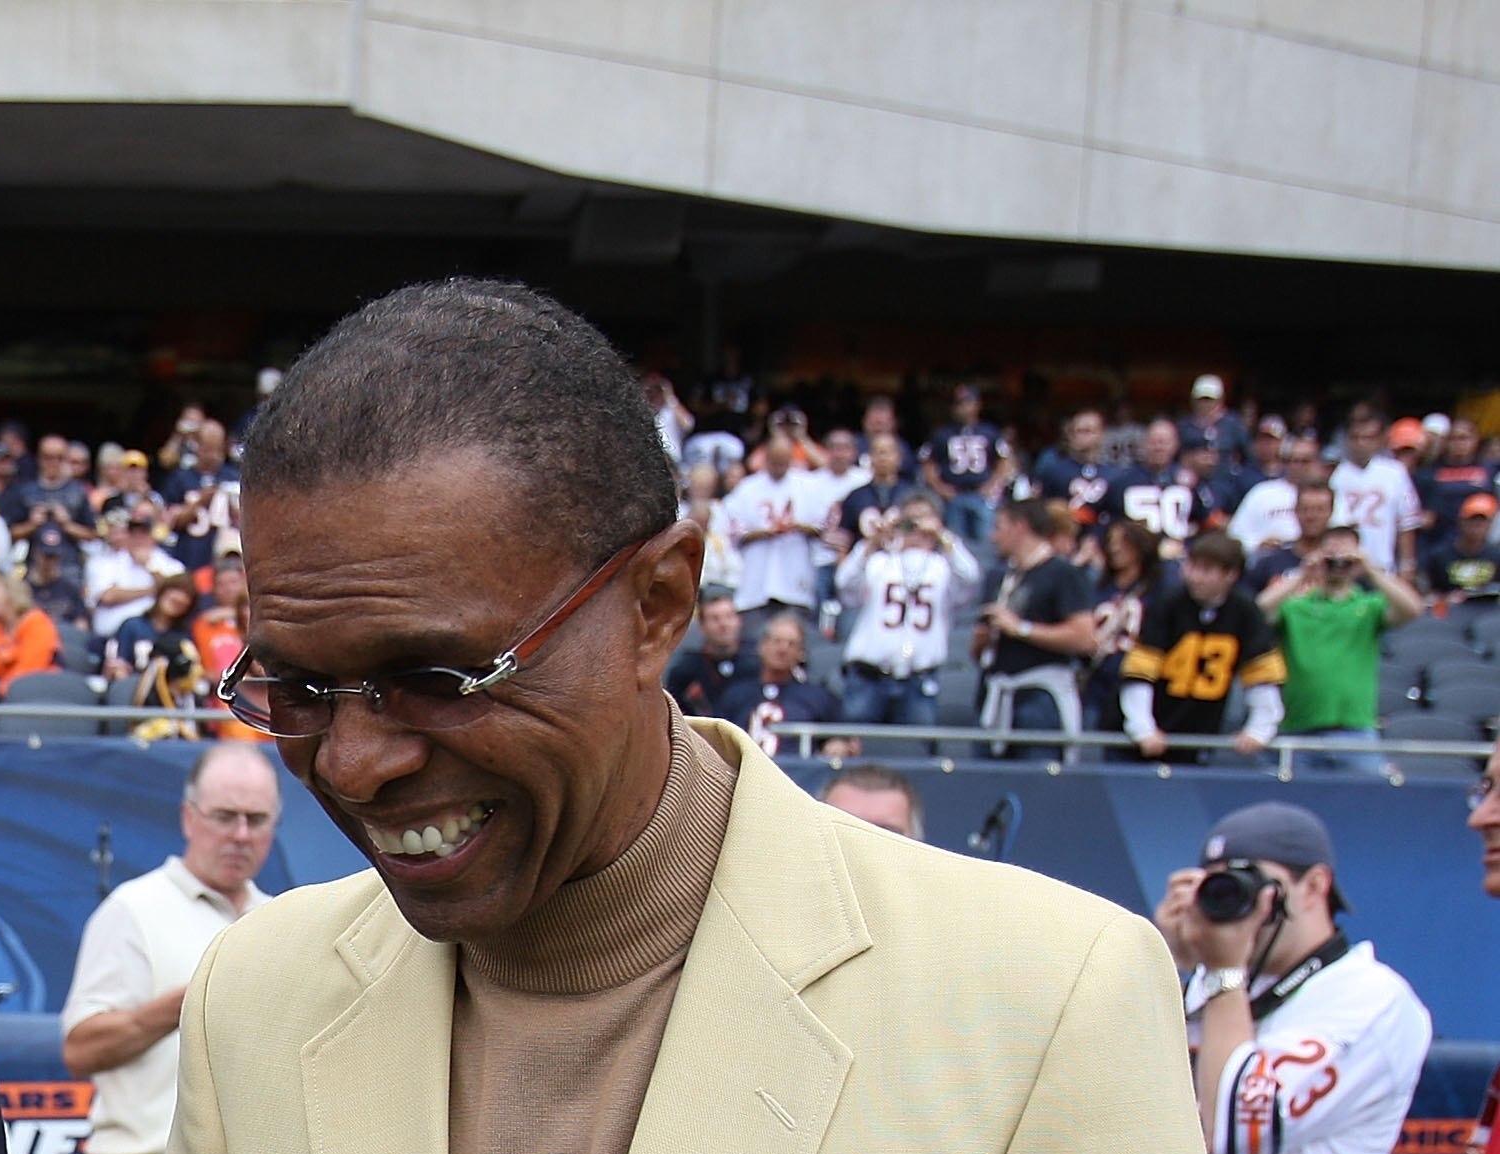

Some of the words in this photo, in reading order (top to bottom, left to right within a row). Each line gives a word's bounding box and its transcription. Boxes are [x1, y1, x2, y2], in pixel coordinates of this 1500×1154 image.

[1124, 485, 1192, 540] 50
[884, 583, 932, 631] 55
[1163, 631, 1240, 701] 43
[1272, 1040, 1338, 1118] 23
